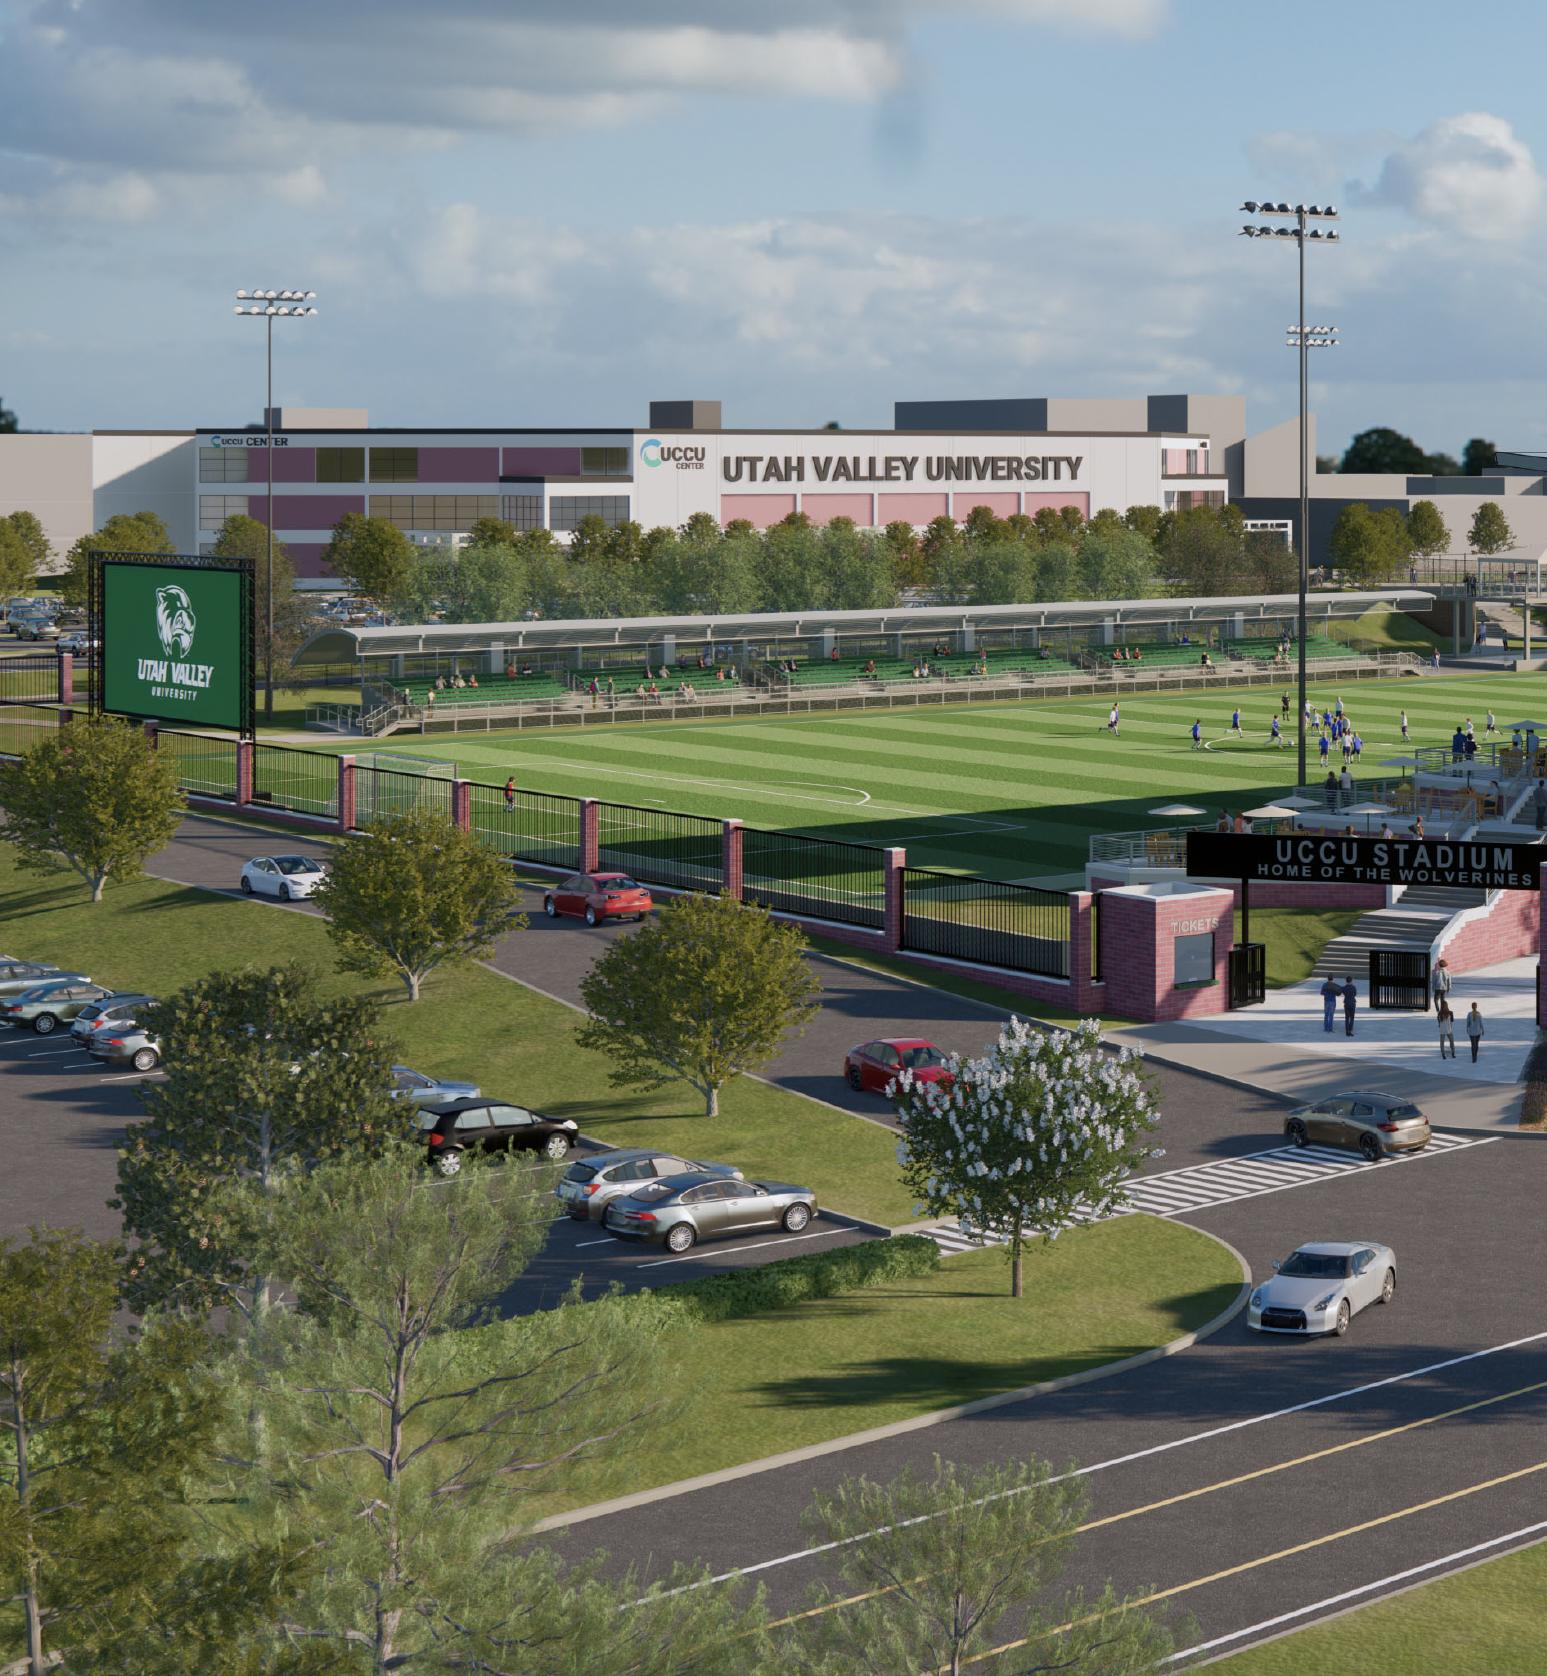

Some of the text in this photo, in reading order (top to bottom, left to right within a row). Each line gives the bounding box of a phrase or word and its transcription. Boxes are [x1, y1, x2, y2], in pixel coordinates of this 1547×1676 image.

[660, 446, 706, 462] UCCU
[676, 462, 705, 470] CENTER
[723, 456, 1083, 482] UTAH VALLEY UNIVERSITY
[137, 658, 215, 688] UTAH VALLEY
[151, 686, 198, 701] UNIVERSITY
[1276, 839, 1513, 871] UCCU STADIUM
[1257, 863, 1533, 886] HOME OF THE WOLVERINES
[1170, 917, 1219, 933] TICKETS
